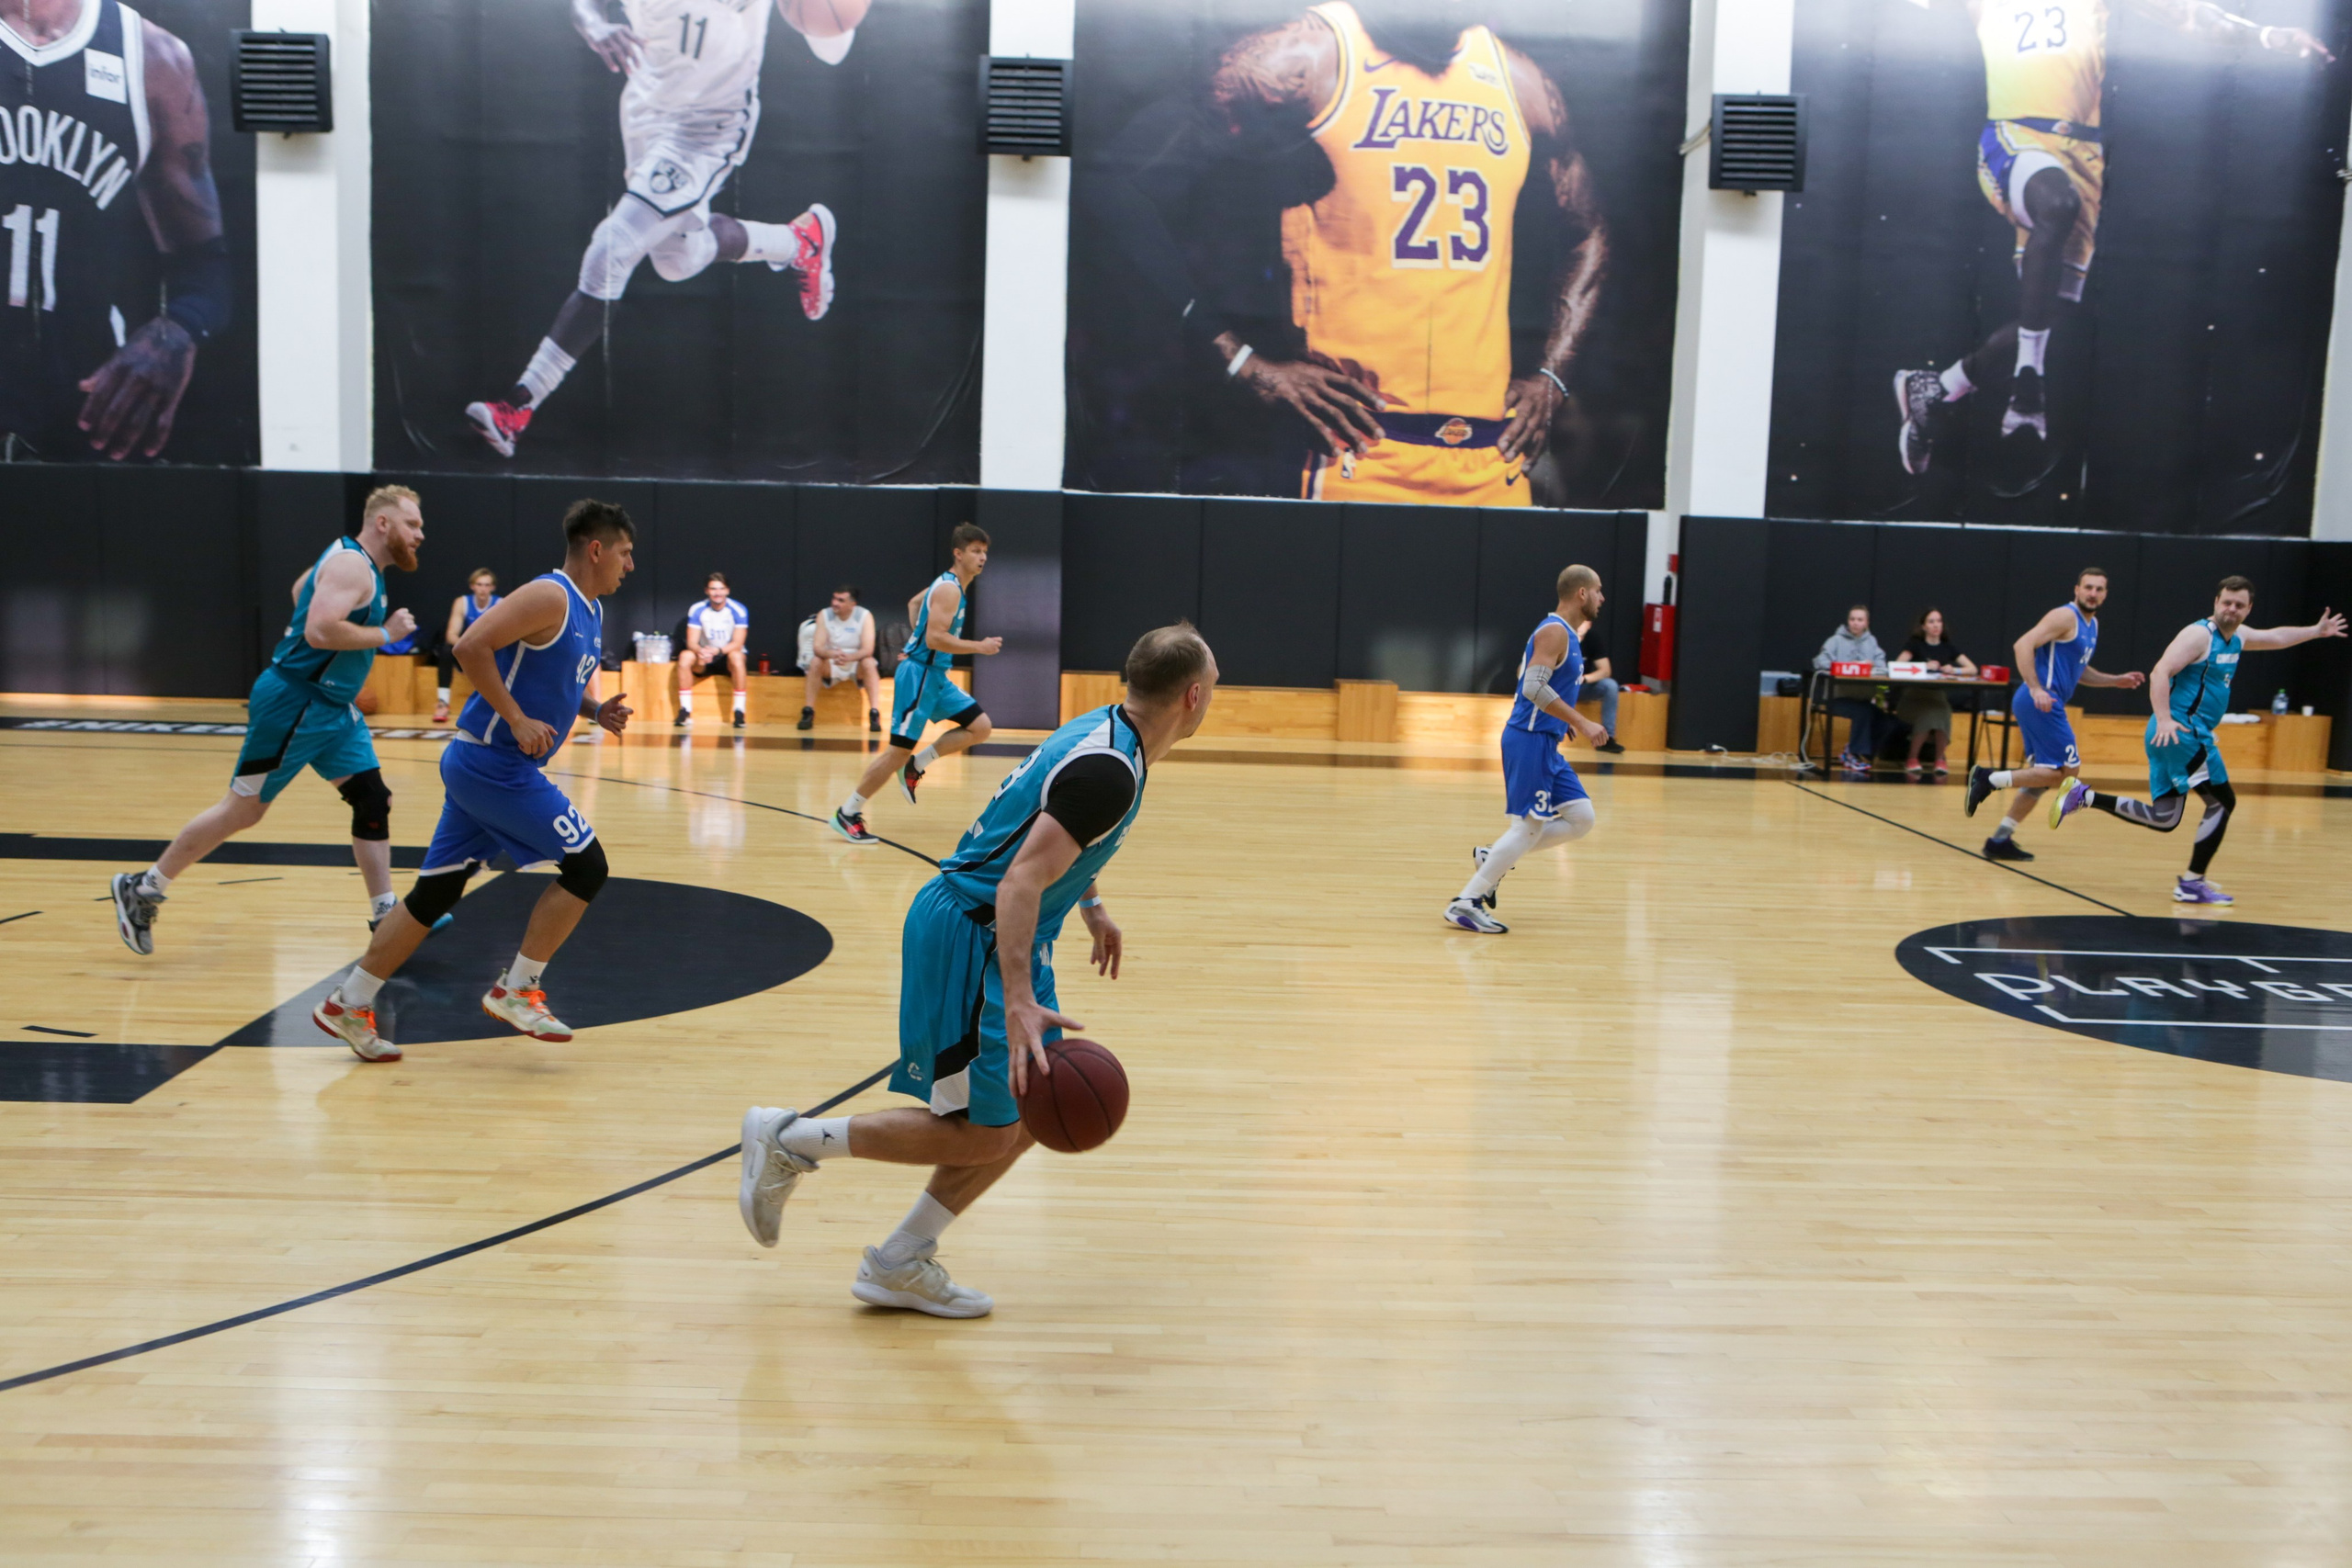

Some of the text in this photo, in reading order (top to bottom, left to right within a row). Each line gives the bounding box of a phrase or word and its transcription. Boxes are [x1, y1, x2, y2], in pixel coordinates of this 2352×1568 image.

[678, 13, 708, 59] 11
[2014, 6, 2066, 52] 23
[1351, 88, 1510, 156] LAKERS
[1392, 165, 1494, 266] 23
[2, 204, 60, 311] 11
[576, 653, 596, 684] 92
[2065, 744, 2078, 762] 2
[553, 805, 589, 844] 92
